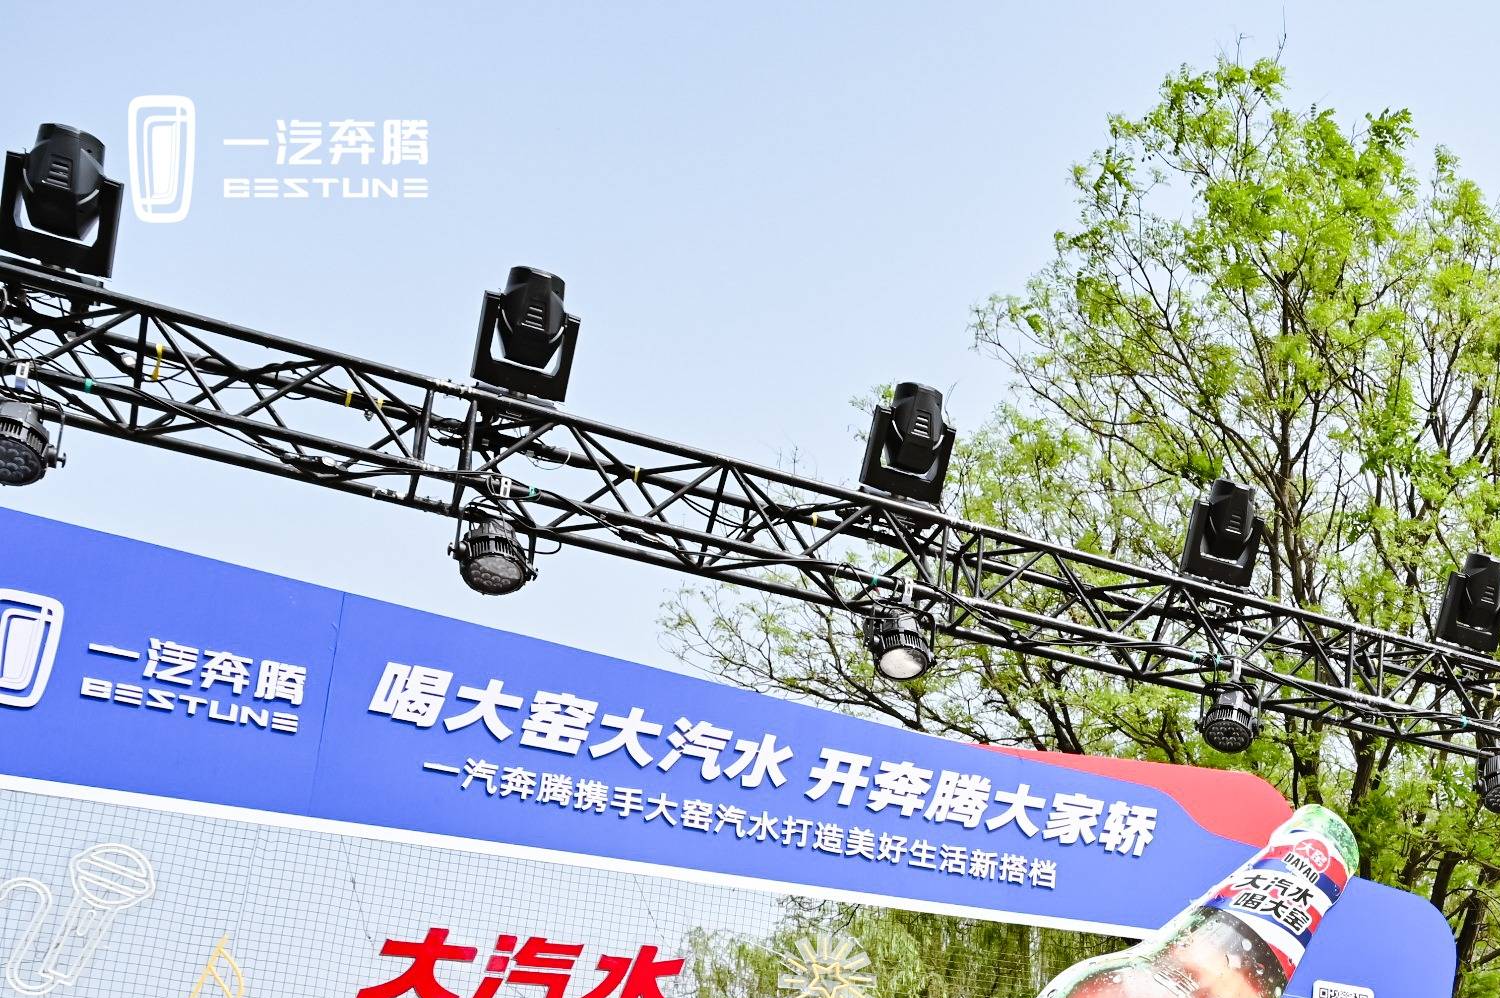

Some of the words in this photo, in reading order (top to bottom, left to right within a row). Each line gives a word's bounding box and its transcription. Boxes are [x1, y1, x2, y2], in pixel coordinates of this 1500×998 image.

[88, 637, 307, 706] 一汽奔腾
[80, 676, 300, 735] BESTUNE
[368, 661, 795, 789] 喝大窑大汽水
[808, 747, 1158, 858] 开奔腾大家轿
[424, 757, 1057, 889] 一汽奔腾携手大窑汽水打造美好生活新搭档
[1235, 875, 1314, 906] 大汽水
[1284, 853, 1318, 883] DAYAO
[1233, 892, 1310, 931] 喝大窑
